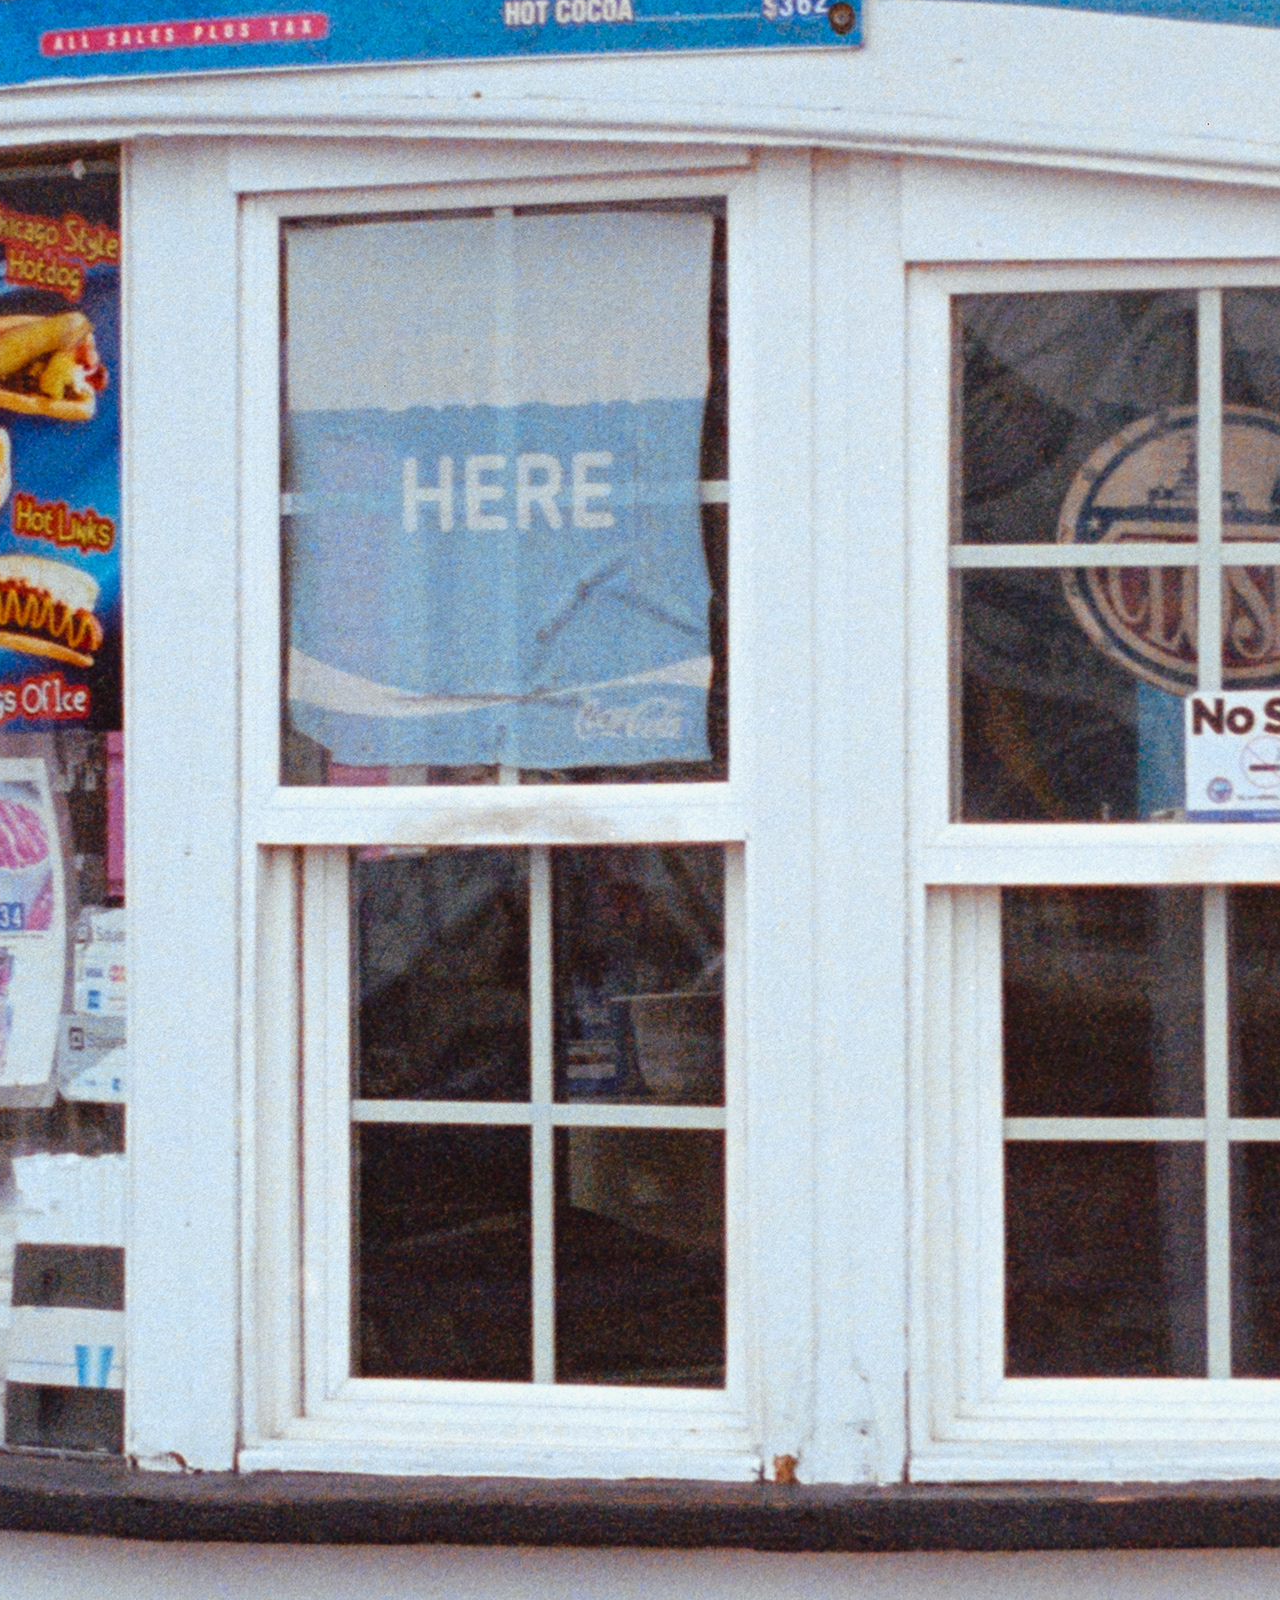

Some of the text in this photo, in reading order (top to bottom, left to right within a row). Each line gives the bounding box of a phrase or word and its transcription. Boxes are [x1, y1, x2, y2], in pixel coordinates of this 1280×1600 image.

[504, 0, 548, 27] HOT
[54, 33, 90, 50] ALL
[107, 27, 174, 47] SALES
[270, 18, 313, 37] TAX
[64, 220, 119, 261] Style
[8, 252, 82, 297] Hotdog
[401, 450, 616, 533] HERE
[16, 497, 112, 547] Hot Links
[22, 681, 52, 713] Of
[53, 679, 87, 712] Ice
[1192, 697, 1255, 735] No
